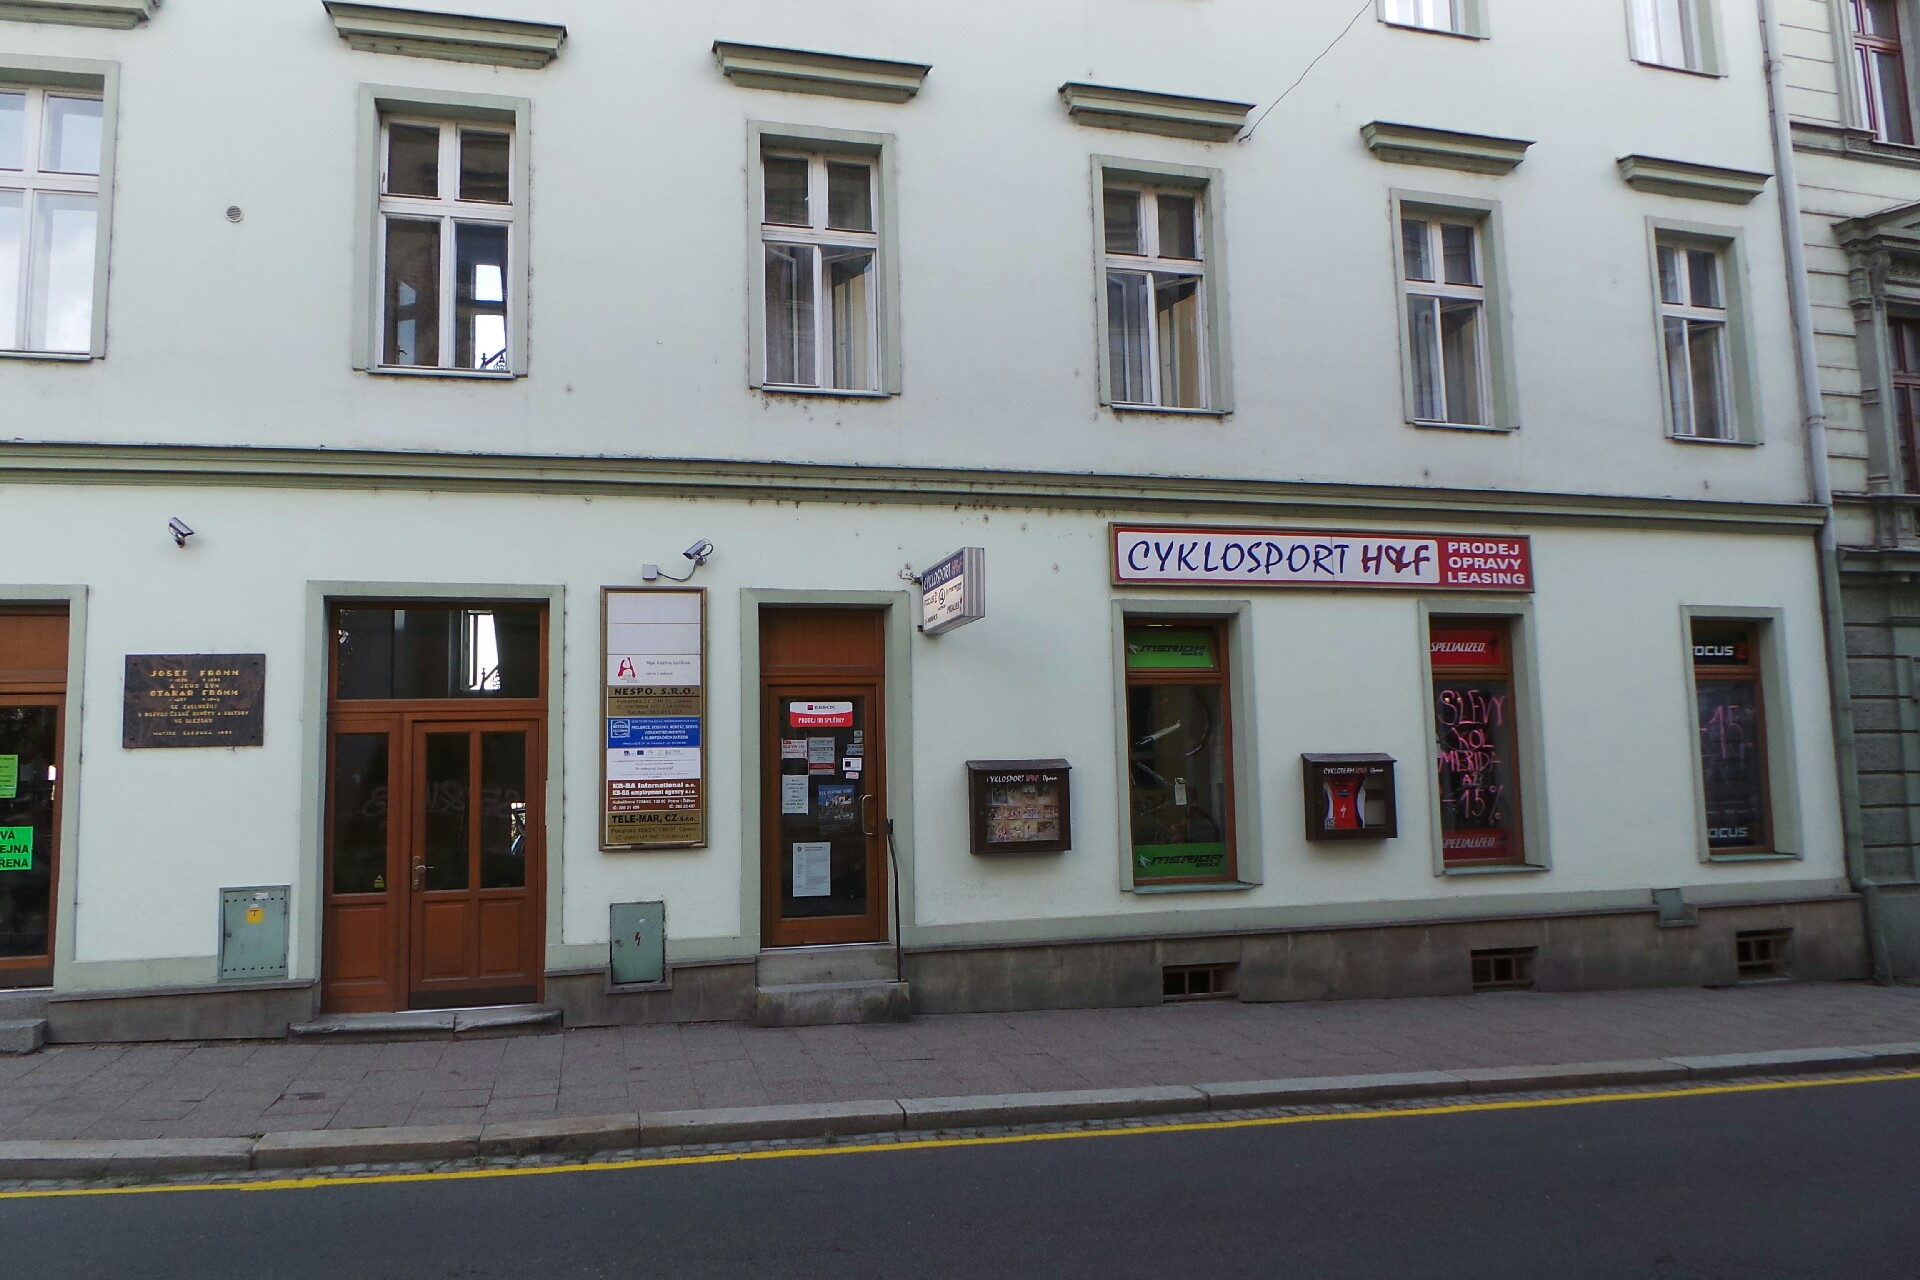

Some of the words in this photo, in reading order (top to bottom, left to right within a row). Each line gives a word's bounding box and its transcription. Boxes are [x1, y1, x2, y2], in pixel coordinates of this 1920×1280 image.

[1447, 541, 1520, 555] PRODEJ
[1128, 540, 1349, 575] CYKLOSPORT
[1361, 544, 1430, 576] H&F
[1448, 556, 1521, 570] OPRAVY
[1447, 571, 1525, 585] LEASING
[1140, 644, 1206, 653] MERIDA
[1430, 642, 1486, 652] SPECIALIZED
[1692, 646, 1734, 656] OCUS
[1438, 690, 1505, 726] SLEVY
[612, 814, 662, 823] TELE-MAR,
[1708, 828, 1748, 838] OCUS
[1151, 854, 1223, 864] MERIDA
